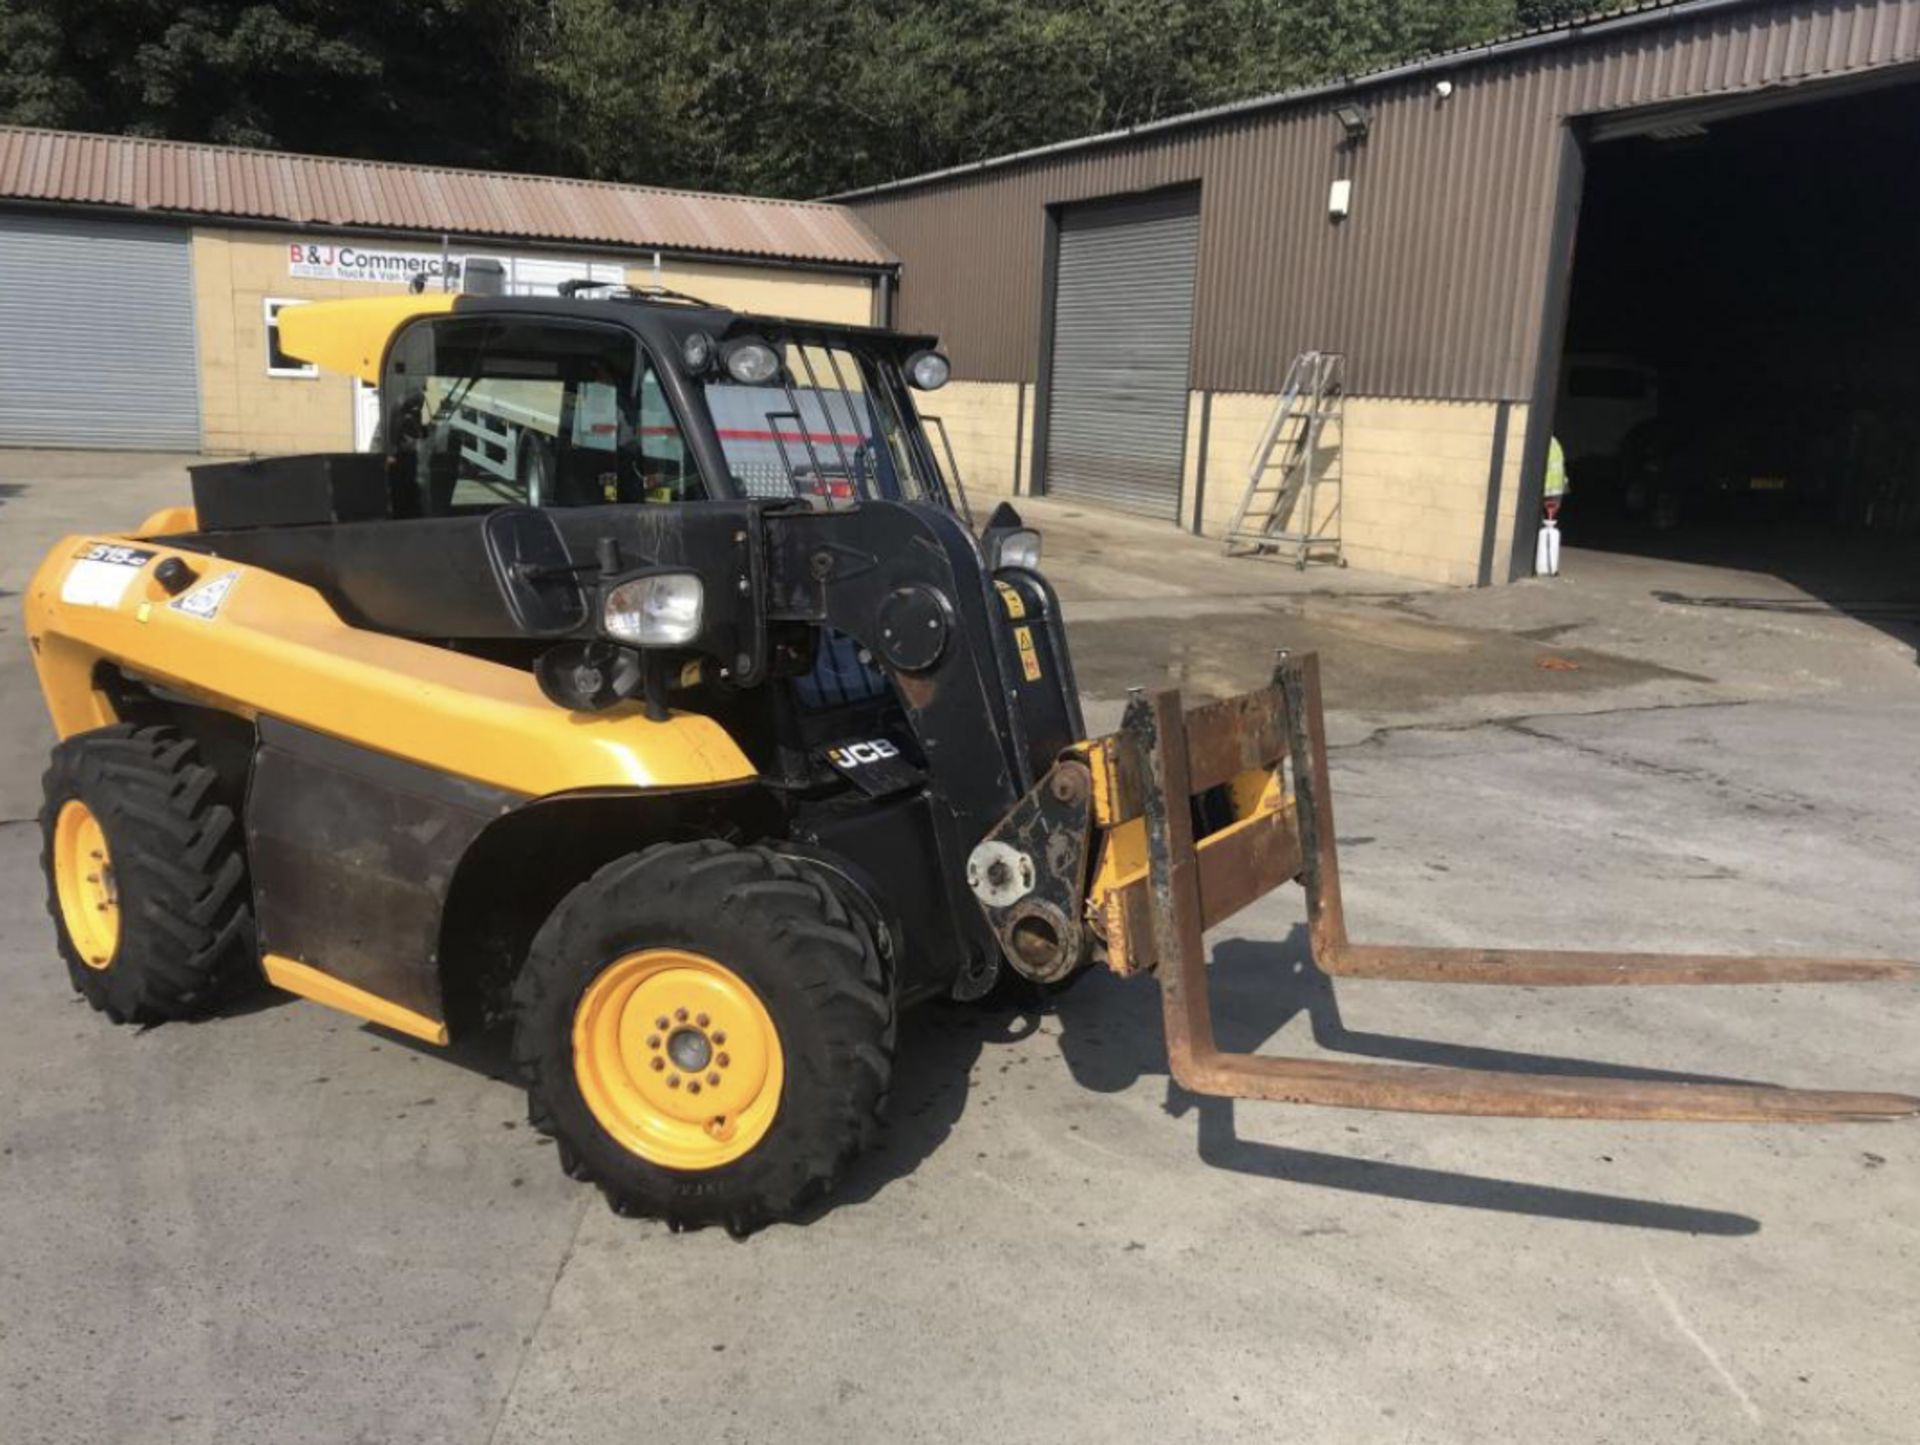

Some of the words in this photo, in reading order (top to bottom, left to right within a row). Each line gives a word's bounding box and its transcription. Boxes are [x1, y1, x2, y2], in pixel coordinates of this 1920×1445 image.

[290, 244, 304, 263] B
[307, 246, 321, 265] &
[324, 246, 334, 266] J
[339, 248, 447, 276] Commerc
[837, 739, 900, 768] JCB
